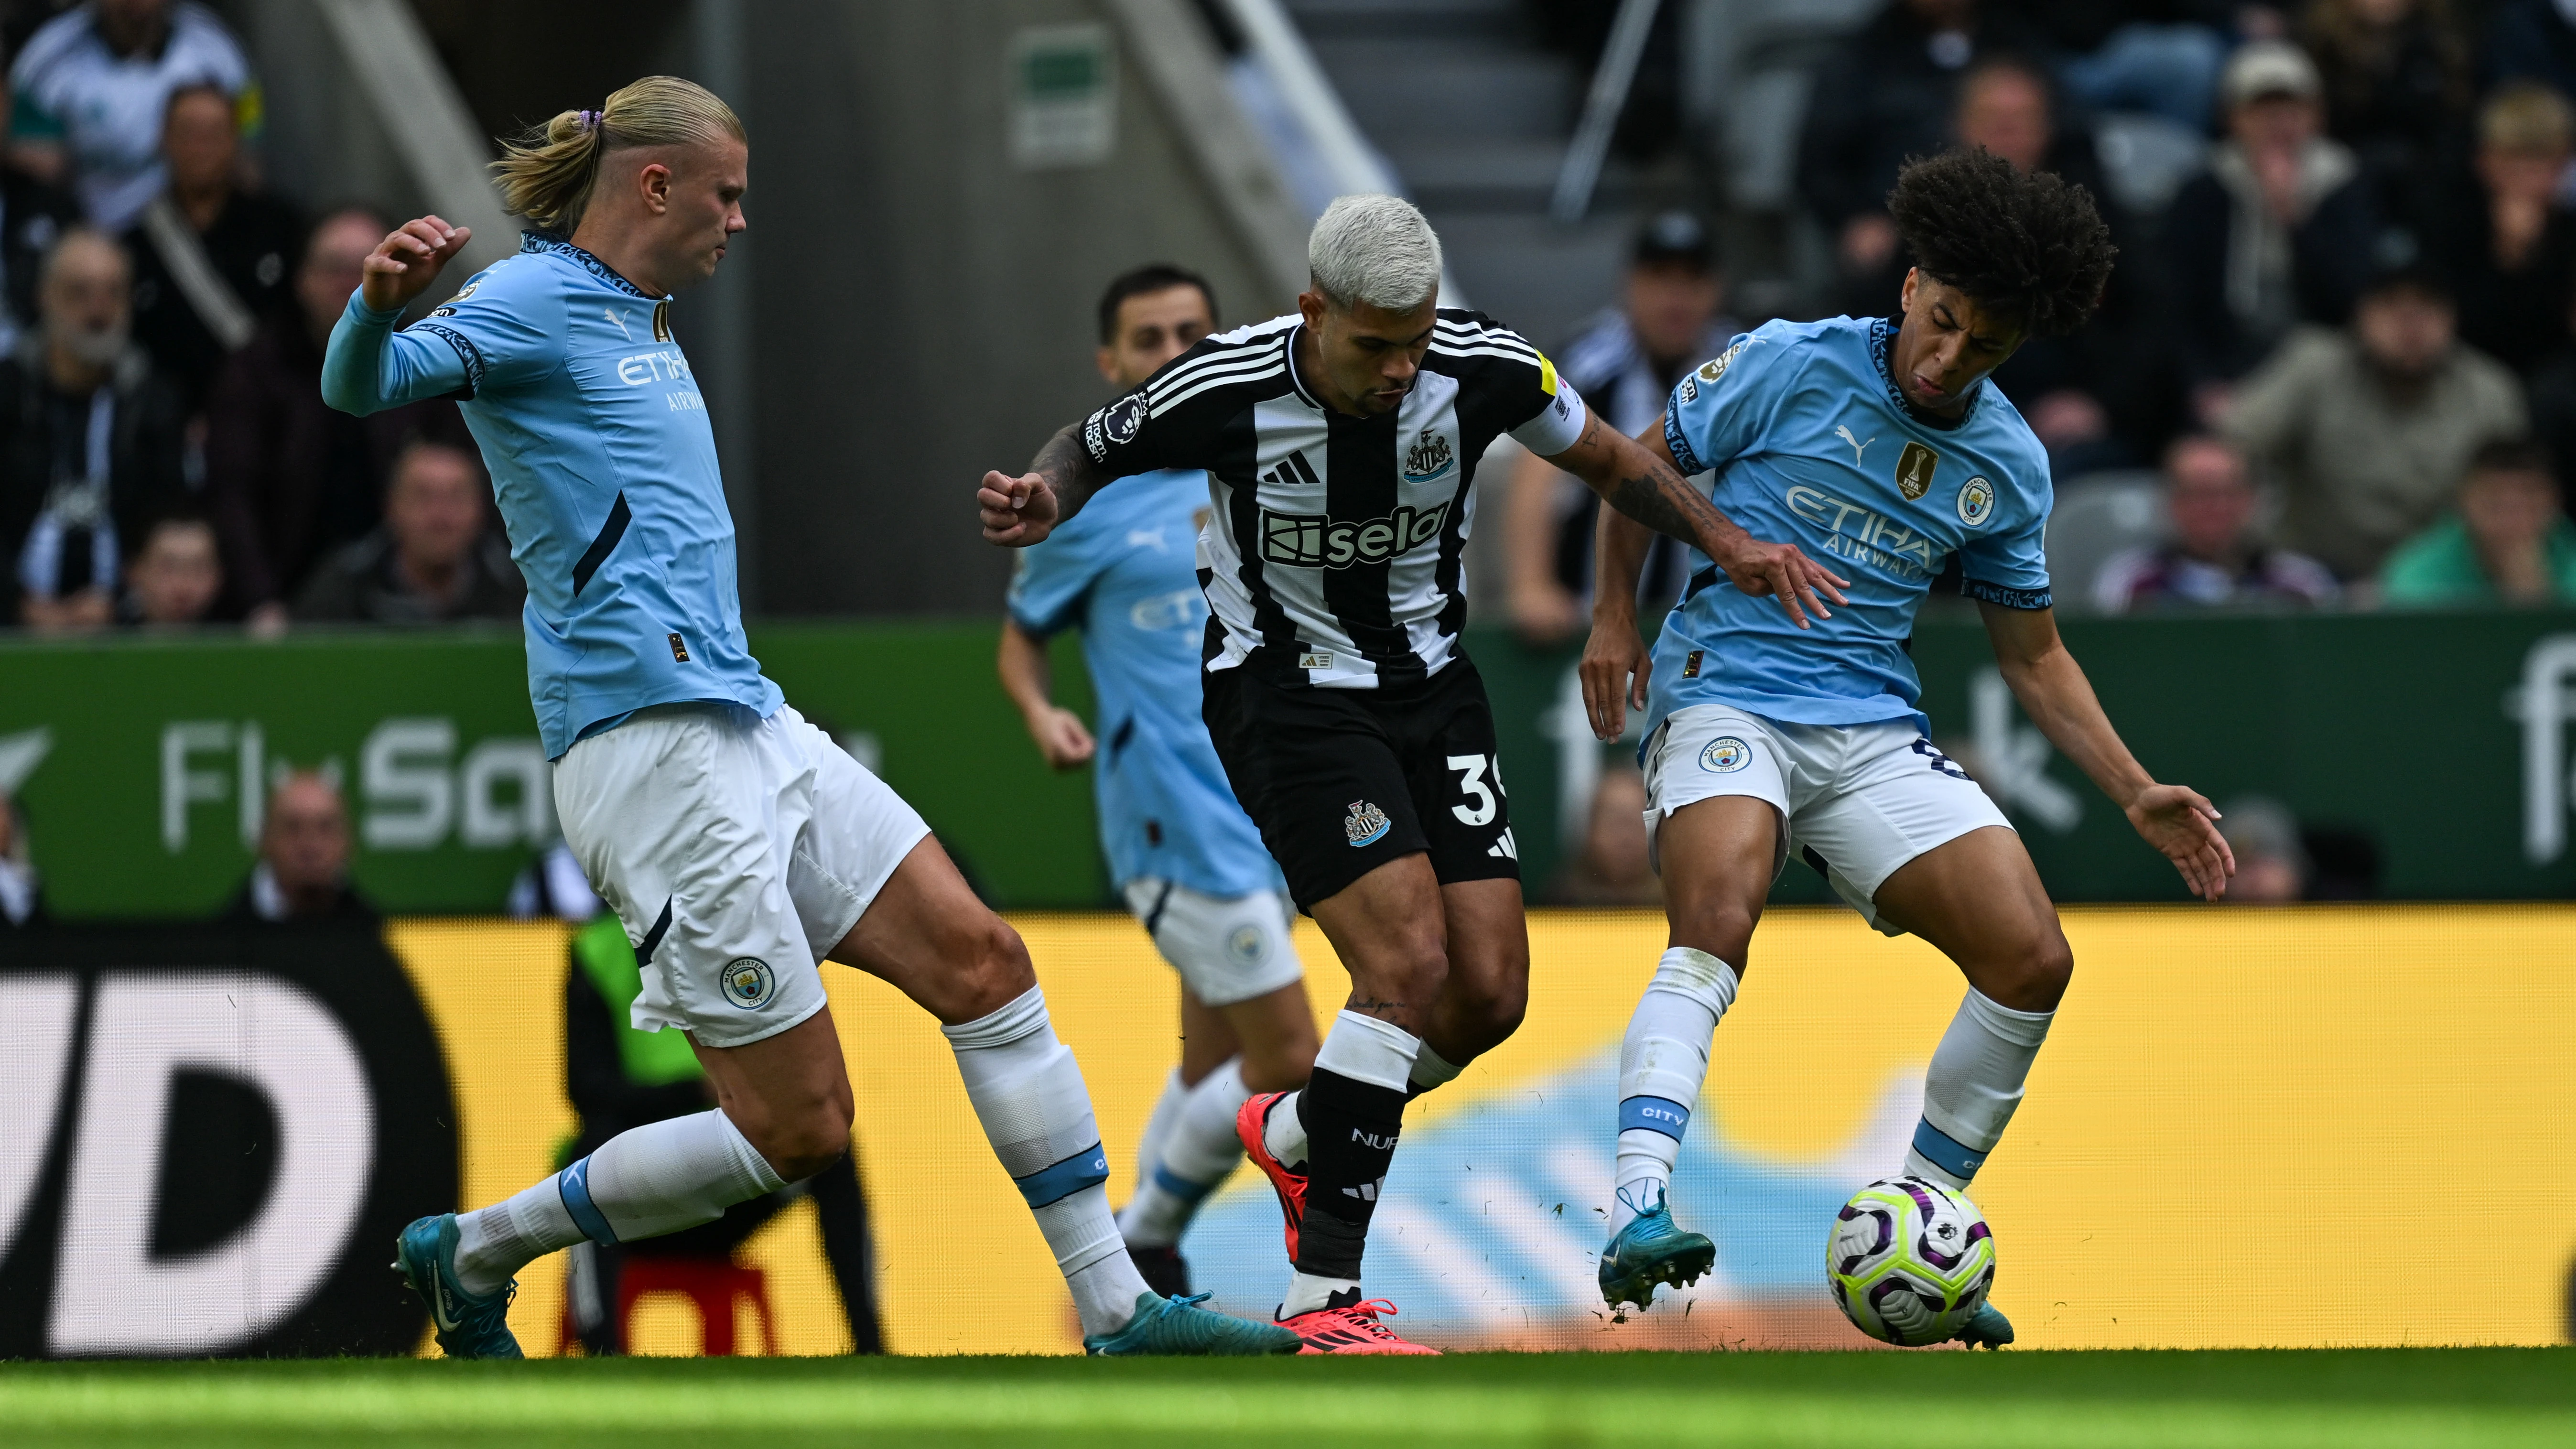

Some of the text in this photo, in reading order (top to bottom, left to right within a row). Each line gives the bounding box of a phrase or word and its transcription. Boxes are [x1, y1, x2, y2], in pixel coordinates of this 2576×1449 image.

[617, 350, 690, 386] ETIHA
[666, 391, 705, 411] AIRWA
[1085, 425, 1104, 463] racism
[1093, 422, 1107, 455] room
[1904, 477, 1919, 491] FIFA
[1966, 479, 1992, 501] MANCHESTER
[1786, 486, 1932, 569] ETIHA
[1964, 516, 1975, 524] CITY
[1327, 507, 1445, 562] sela
[1704, 740, 1744, 757] MANCHESTER
[725, 961, 764, 983] MANCHESTER
[748, 996, 763, 1006] CITY
[1642, 1107, 1684, 1126] CITY
[1352, 1127, 1399, 1150] NUF
